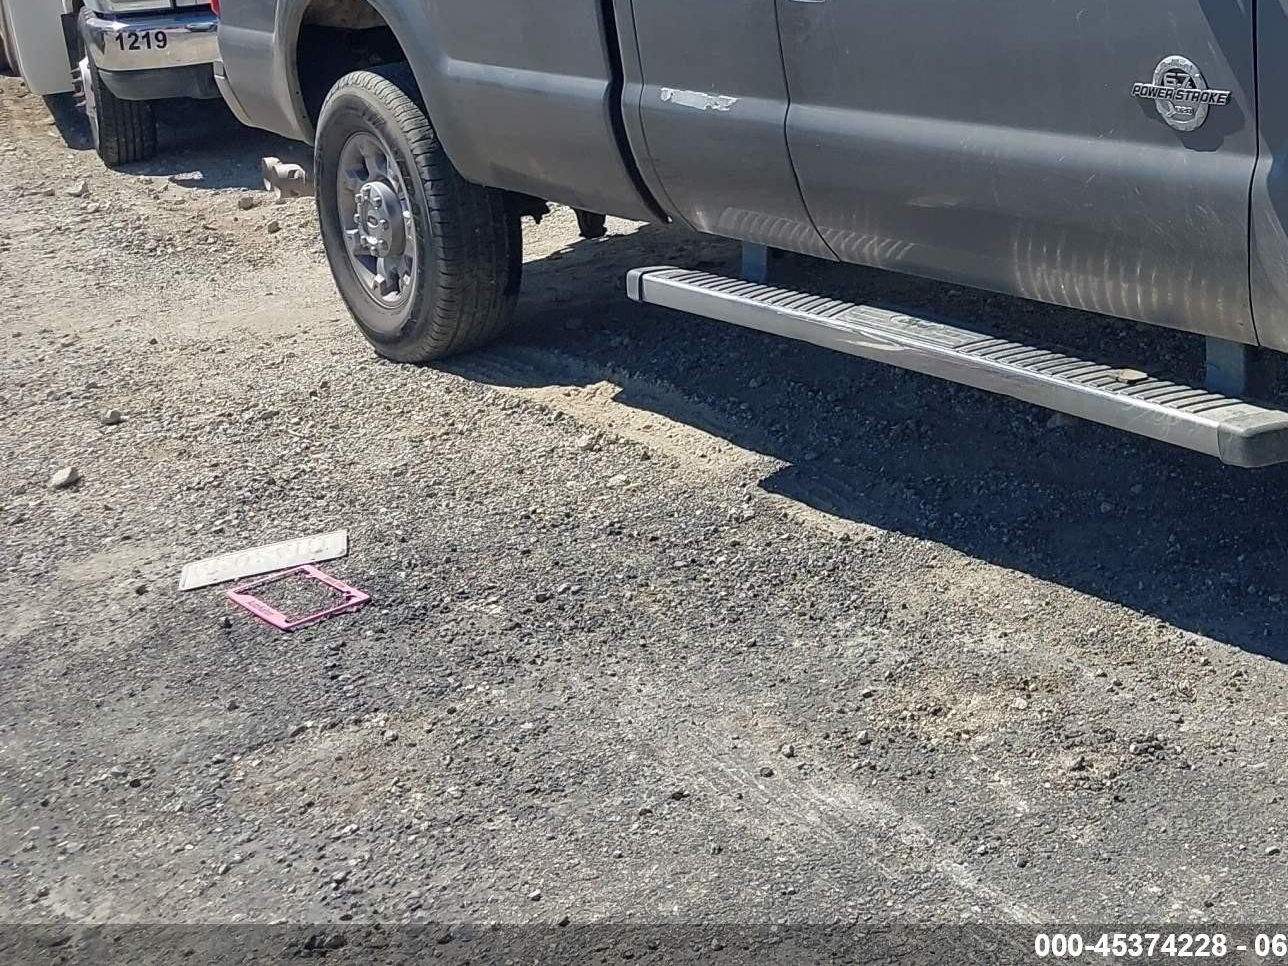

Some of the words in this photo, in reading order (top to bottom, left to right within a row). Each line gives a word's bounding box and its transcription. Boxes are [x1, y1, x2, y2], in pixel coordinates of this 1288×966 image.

[115, 30, 168, 51] 1219
[1131, 84, 1173, 101] POWER
[1175, 89, 1228, 105] STROKE
